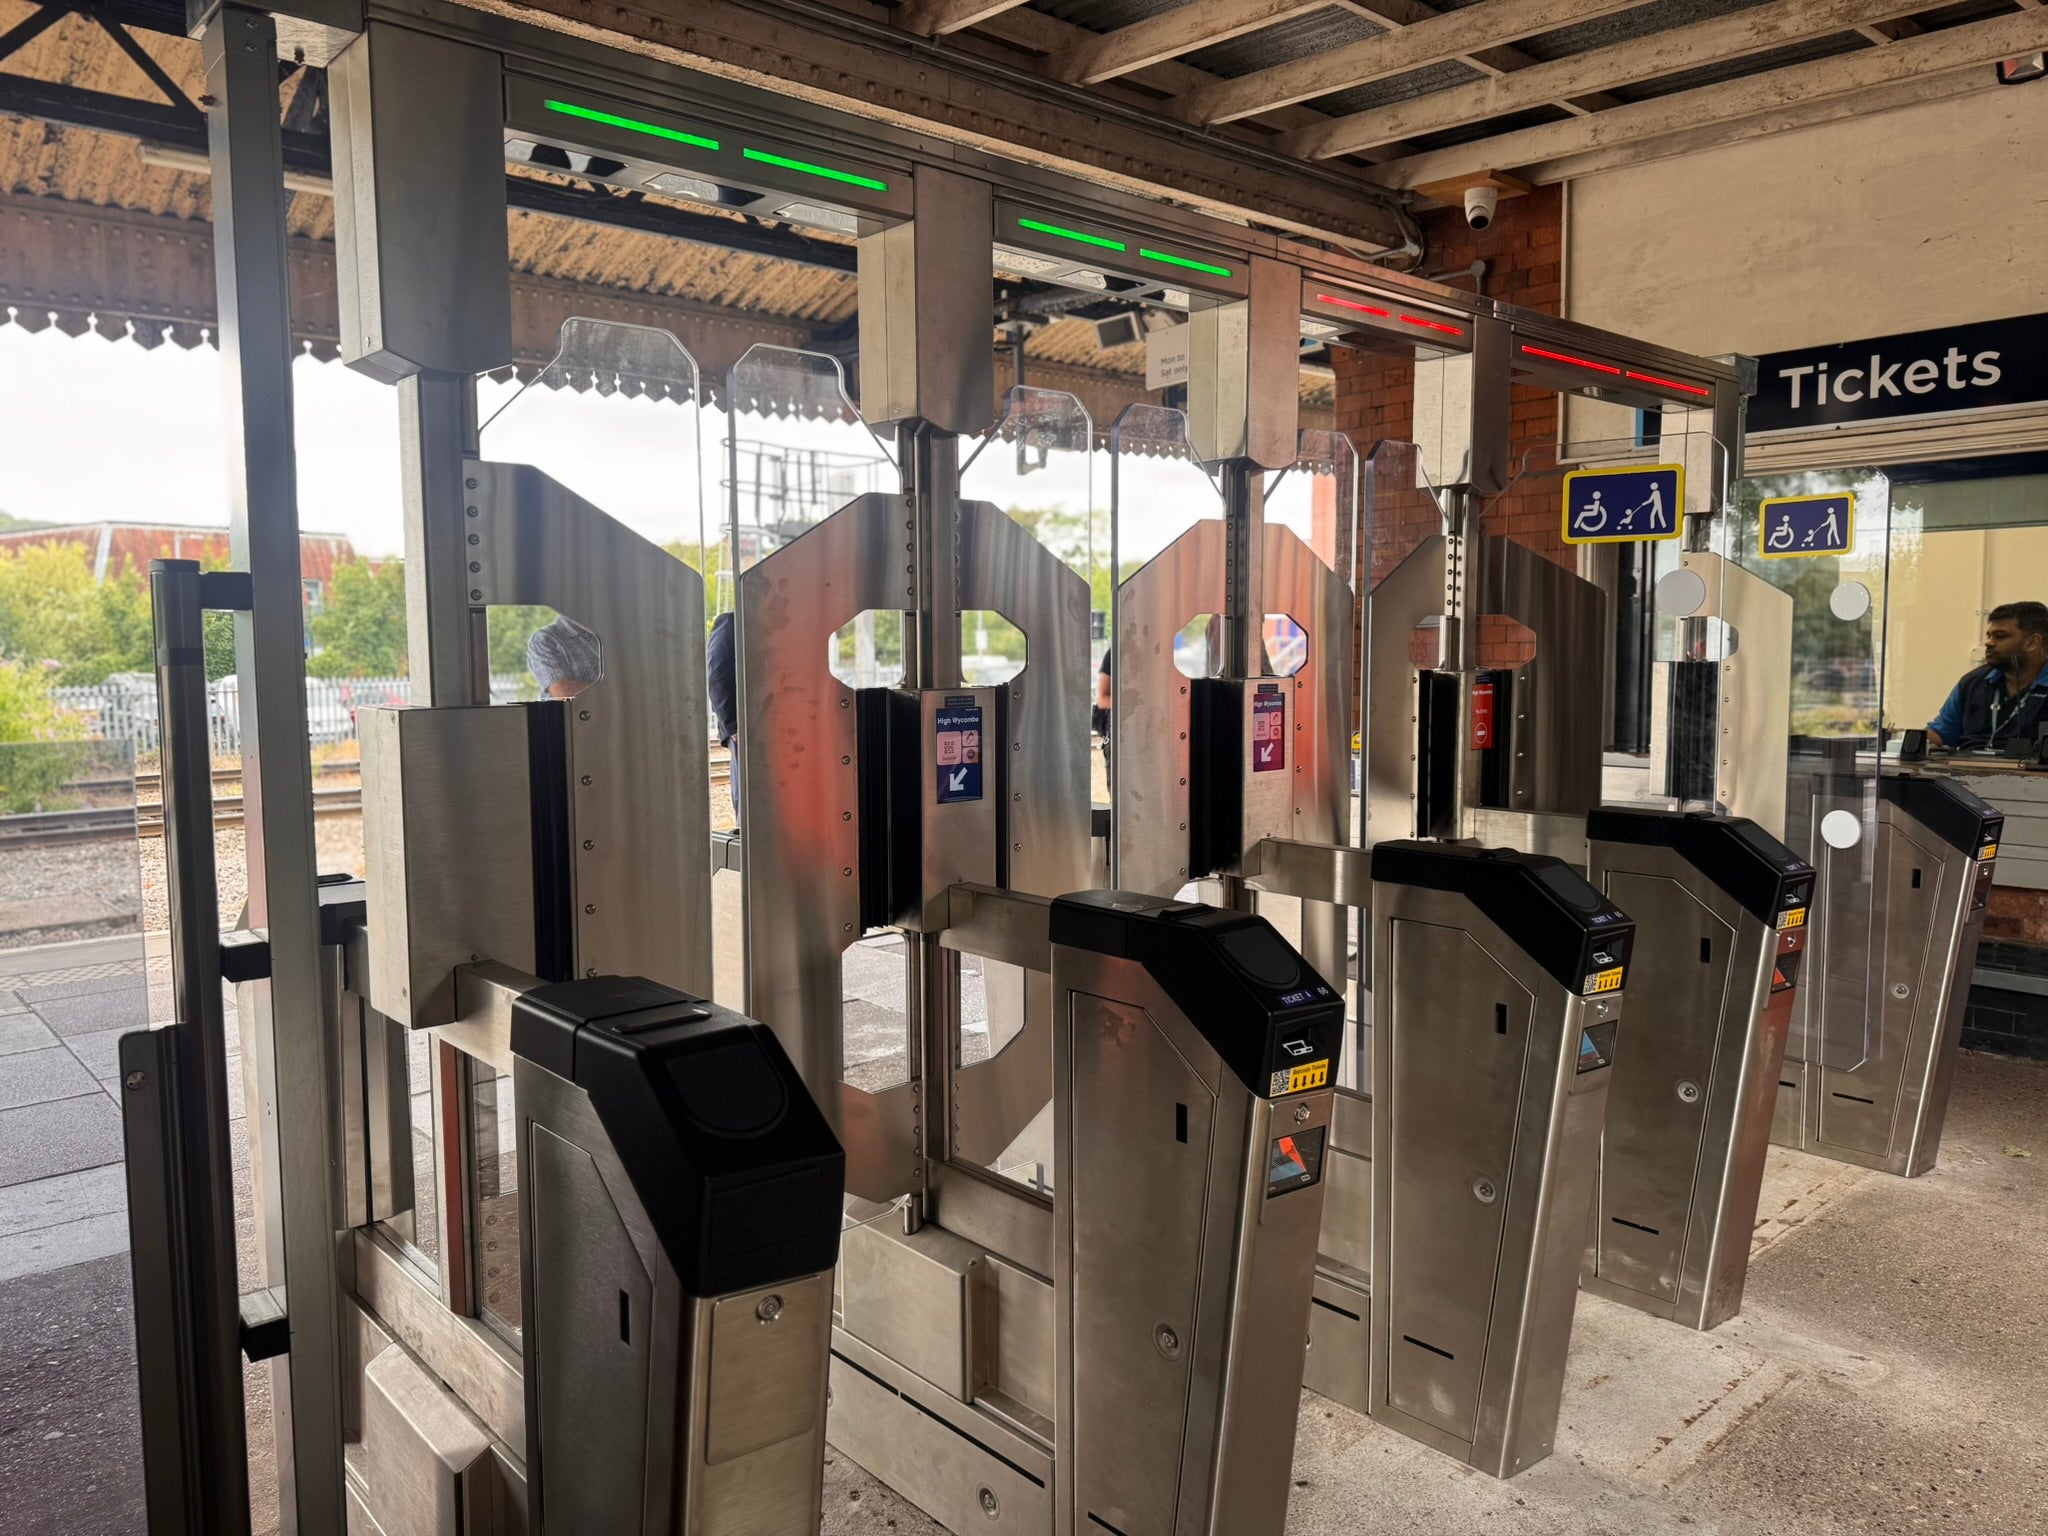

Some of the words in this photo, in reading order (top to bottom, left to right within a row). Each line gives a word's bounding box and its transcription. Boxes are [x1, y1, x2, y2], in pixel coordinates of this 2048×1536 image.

[1161, 356, 1176, 366] Mon
[1177, 354, 1185, 362] to
[1161, 368, 1173, 377] Sat
[1779, 347, 2001, 408] Tickets
[937, 717, 951, 726] High
[952, 716, 979, 725] Wycombe
[1281, 992, 1304, 1004] TICKET
[1292, 1066, 1311, 1075] Barcode
[1311, 1062, 1327, 1071] Tickets
